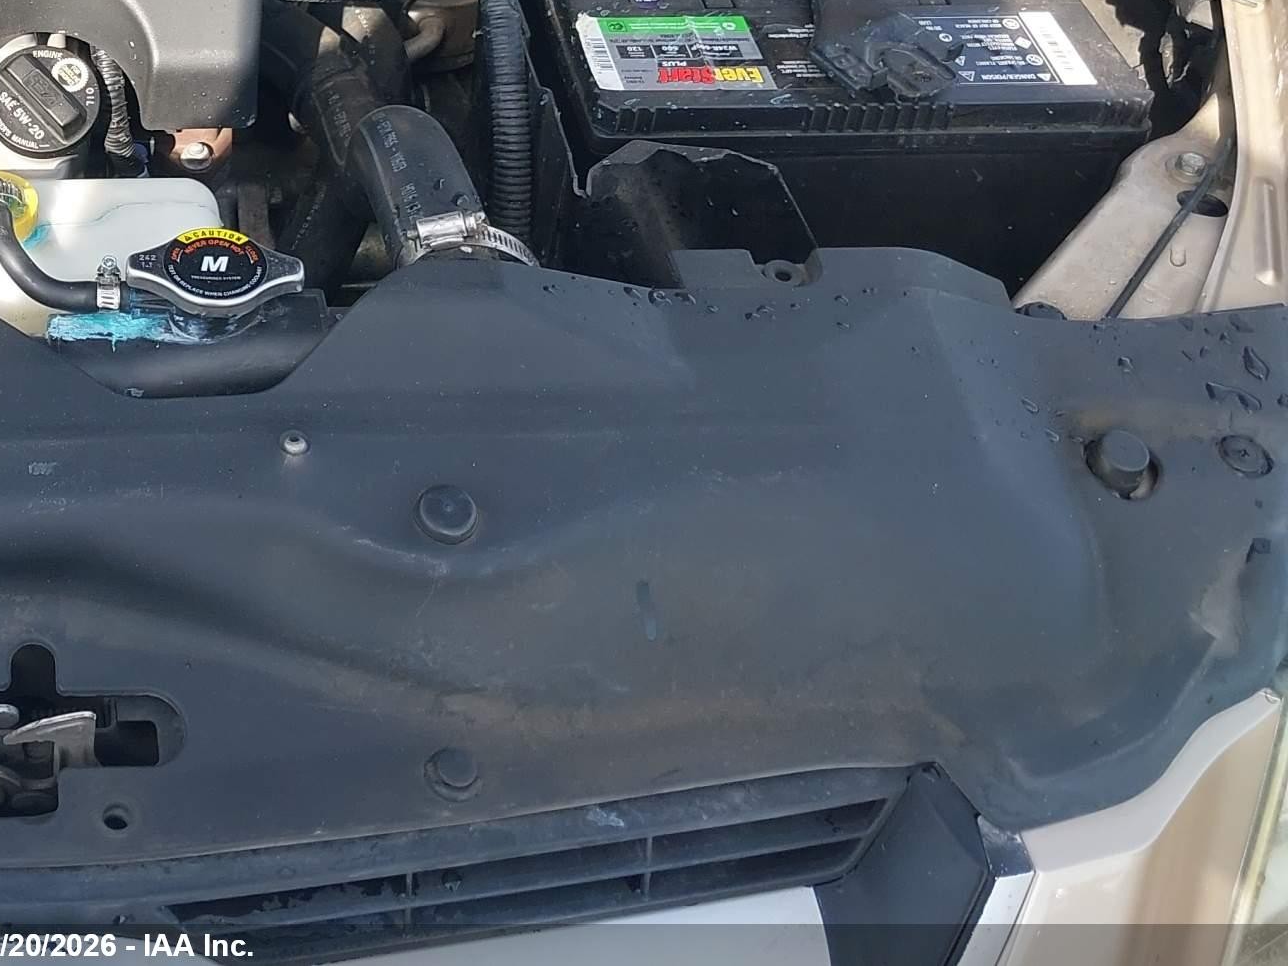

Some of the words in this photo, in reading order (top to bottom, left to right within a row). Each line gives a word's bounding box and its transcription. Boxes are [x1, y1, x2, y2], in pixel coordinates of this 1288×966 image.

[32, 50, 63, 61] ENGINE
[662, 60, 687, 68] PLUS
[85, 87, 95, 107] OIL
[11, 134, 39, 149] MANUAL
[192, 230, 243, 242] CAUTION
[183, 239, 207, 254] NEVER
[208, 238, 231, 248] OPEN
[230, 244, 245, 255] HOT
[200, 255, 230, 272] M
[179, 281, 204, 294] REPLACE
